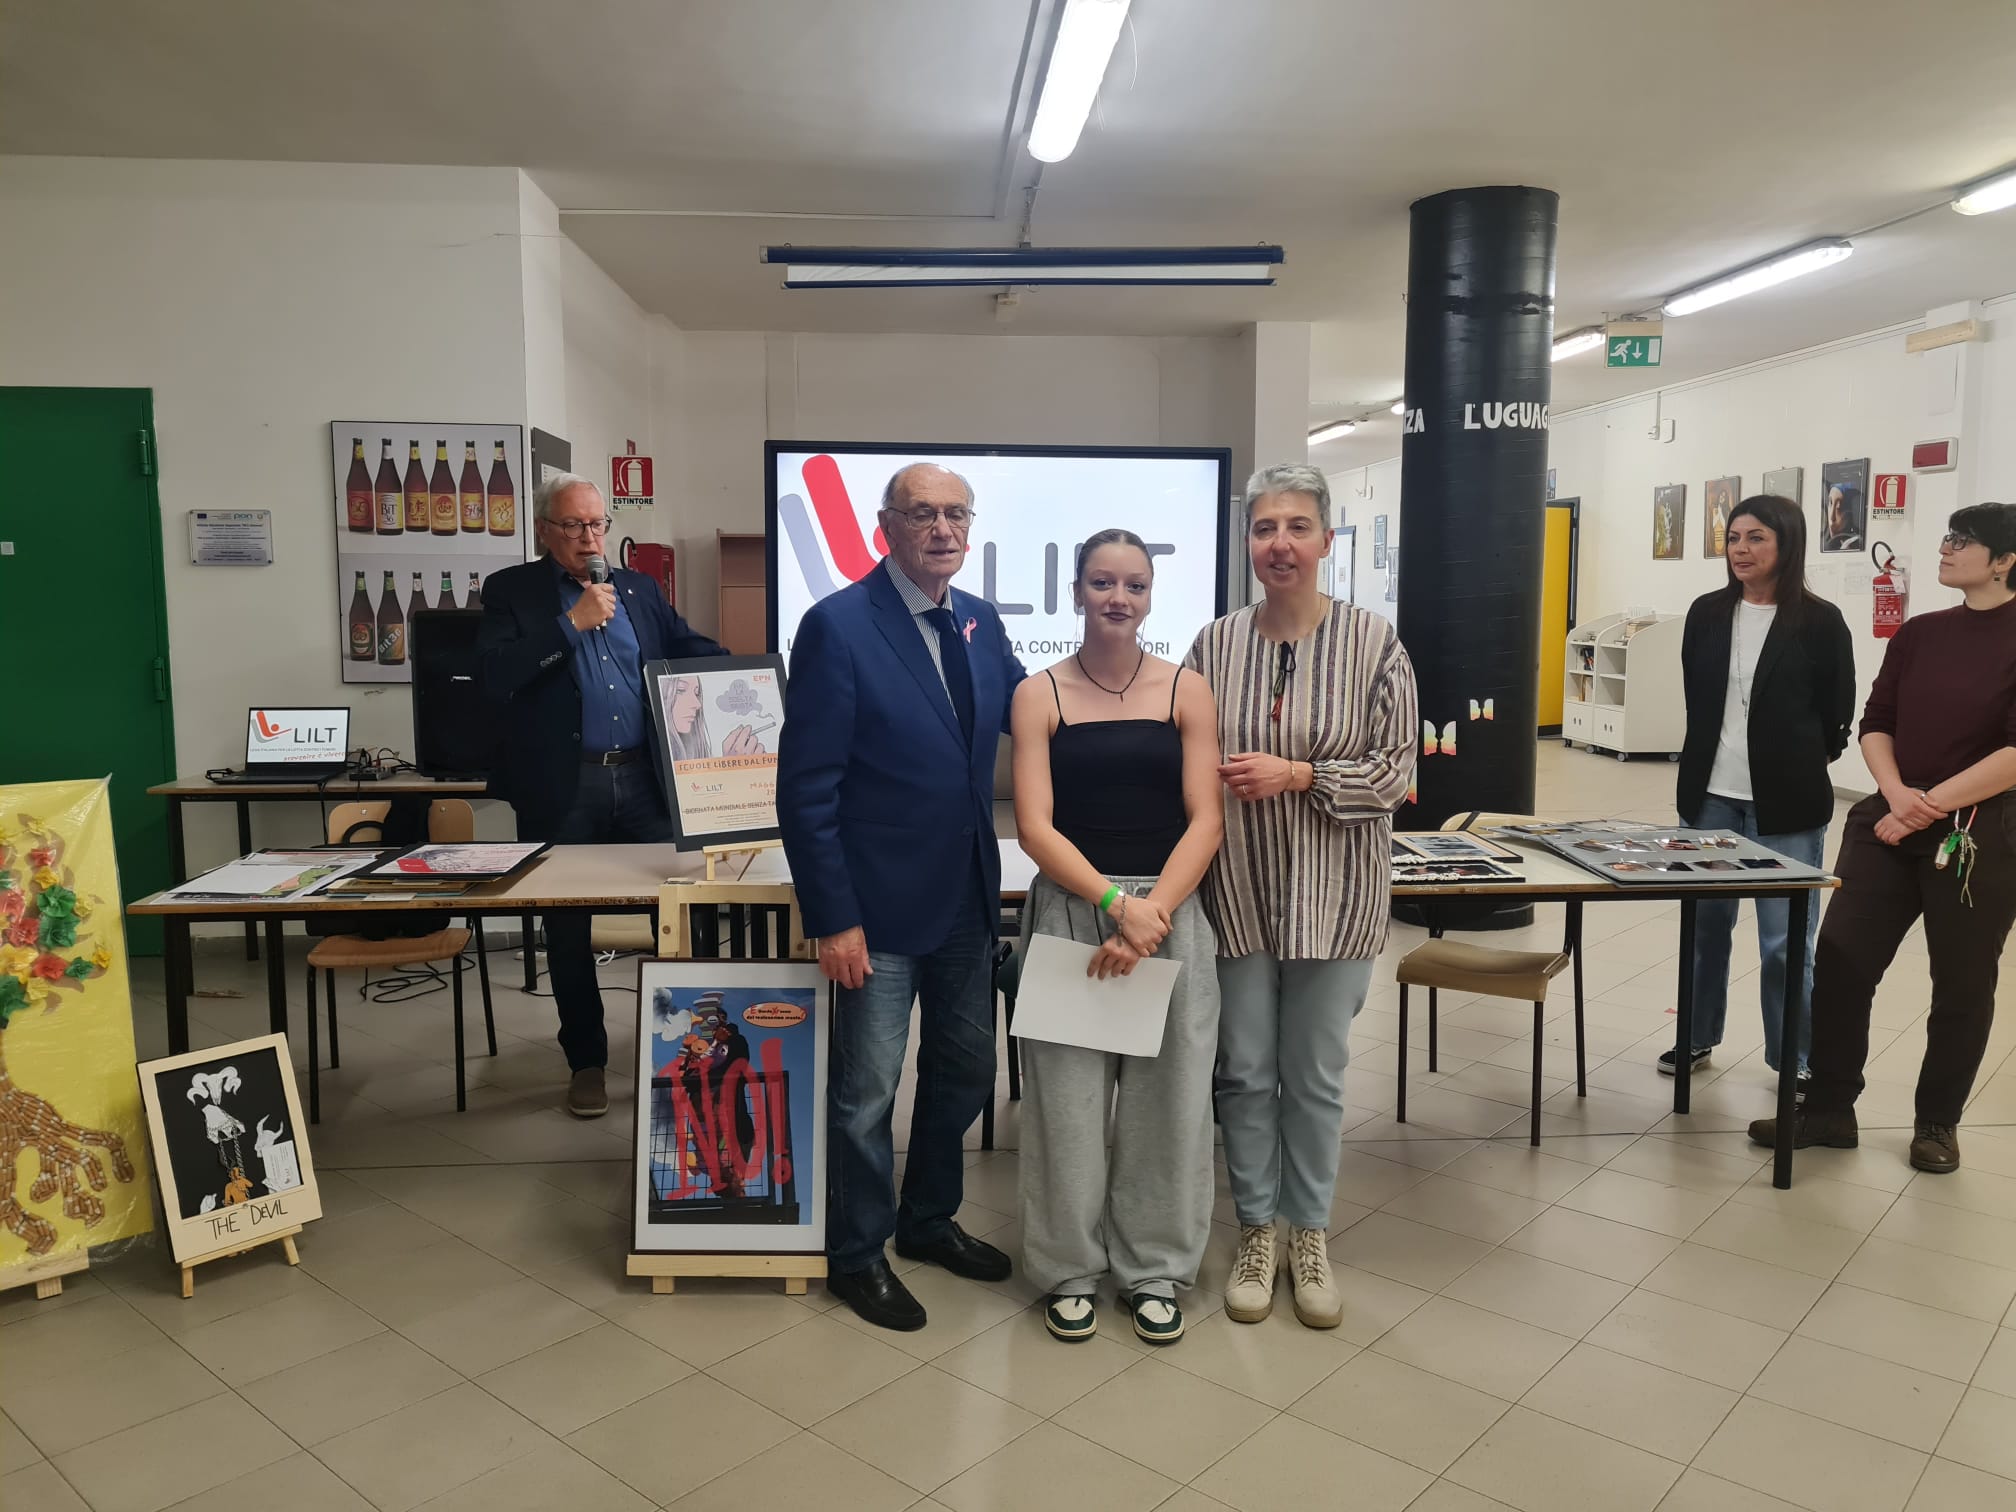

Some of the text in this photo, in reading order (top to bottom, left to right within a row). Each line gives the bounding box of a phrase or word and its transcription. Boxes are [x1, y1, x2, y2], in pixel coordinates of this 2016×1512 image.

[1403, 408, 1425, 435] ZA
[1464, 402, 1550, 430] L'UGUAG
[294, 727, 338, 743] LILT
[744, 758, 760, 766] DAL
[706, 783, 724, 792] LILT
[657, 1038, 792, 1200] NO!
[204, 1212, 241, 1240] THE
